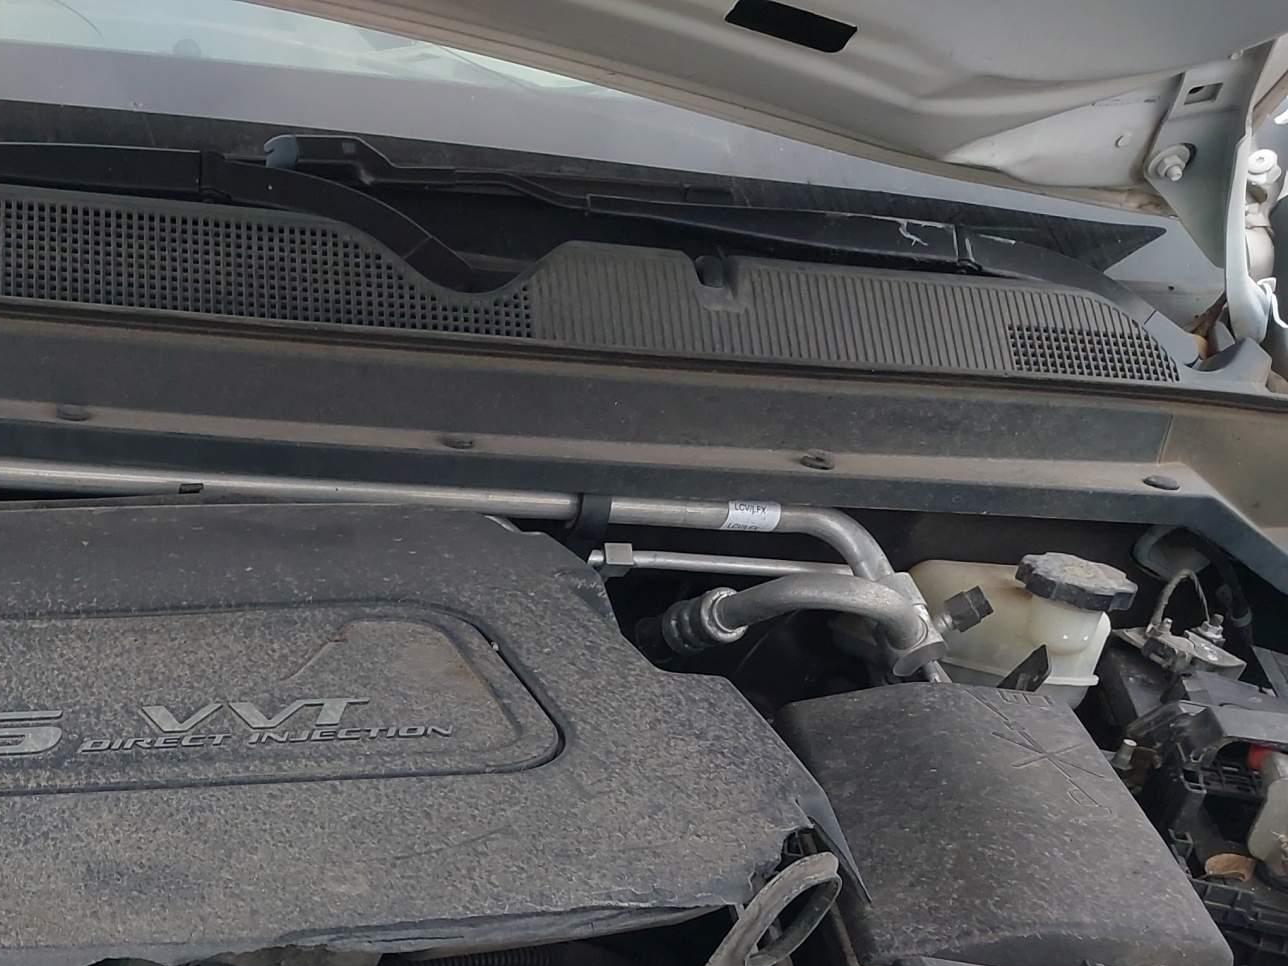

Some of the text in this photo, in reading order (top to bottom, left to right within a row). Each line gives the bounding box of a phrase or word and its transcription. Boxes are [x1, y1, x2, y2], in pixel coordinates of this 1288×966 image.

[139, 699, 370, 733] VVT
[77, 724, 455, 754] DIRECT INJECTION
